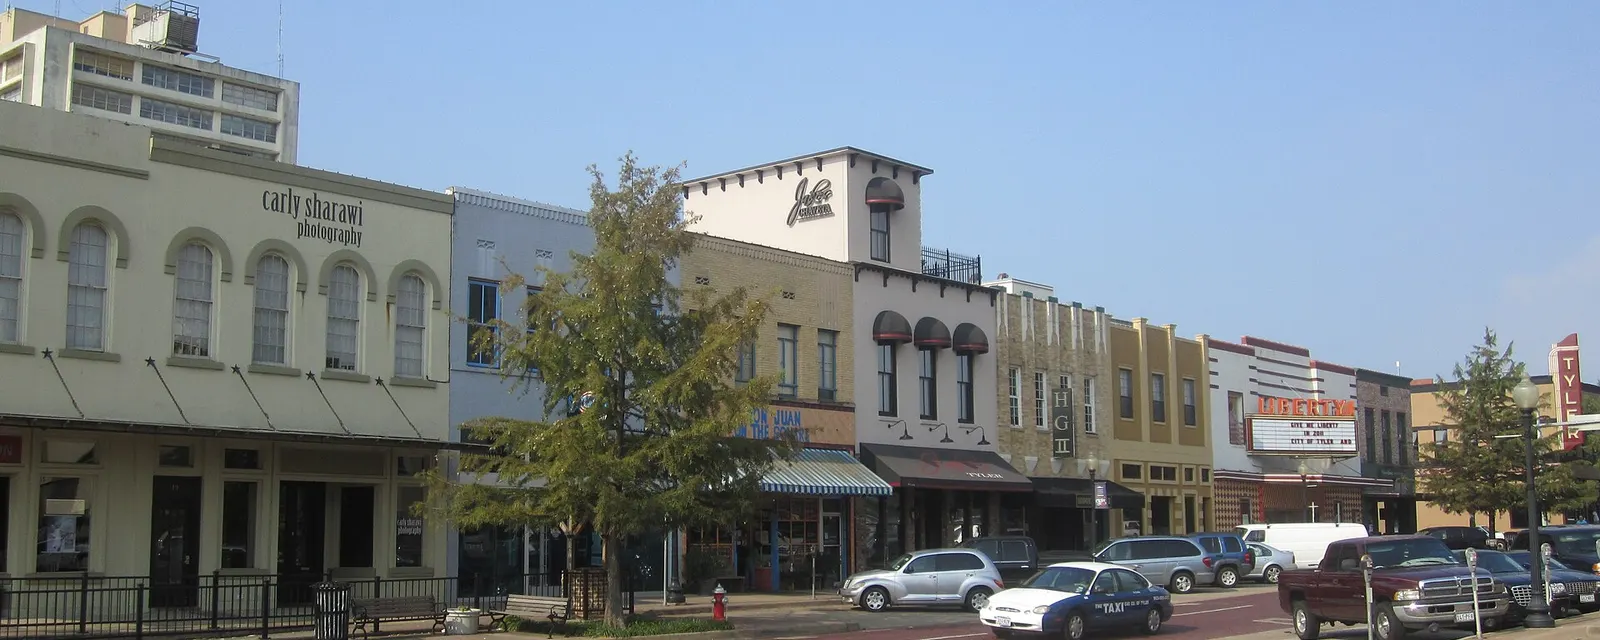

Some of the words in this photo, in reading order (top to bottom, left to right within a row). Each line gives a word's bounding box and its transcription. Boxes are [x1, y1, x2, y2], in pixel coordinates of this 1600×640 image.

[262, 187, 300, 219] carly
[304, 191, 363, 226] sharawi
[297, 218, 363, 248] photography
[1258, 397, 1346, 415] LIBERTY
[773, 410, 801, 426] JUAN
[751, 423, 769, 440] THE
[1103, 602, 1124, 613] TAXI
